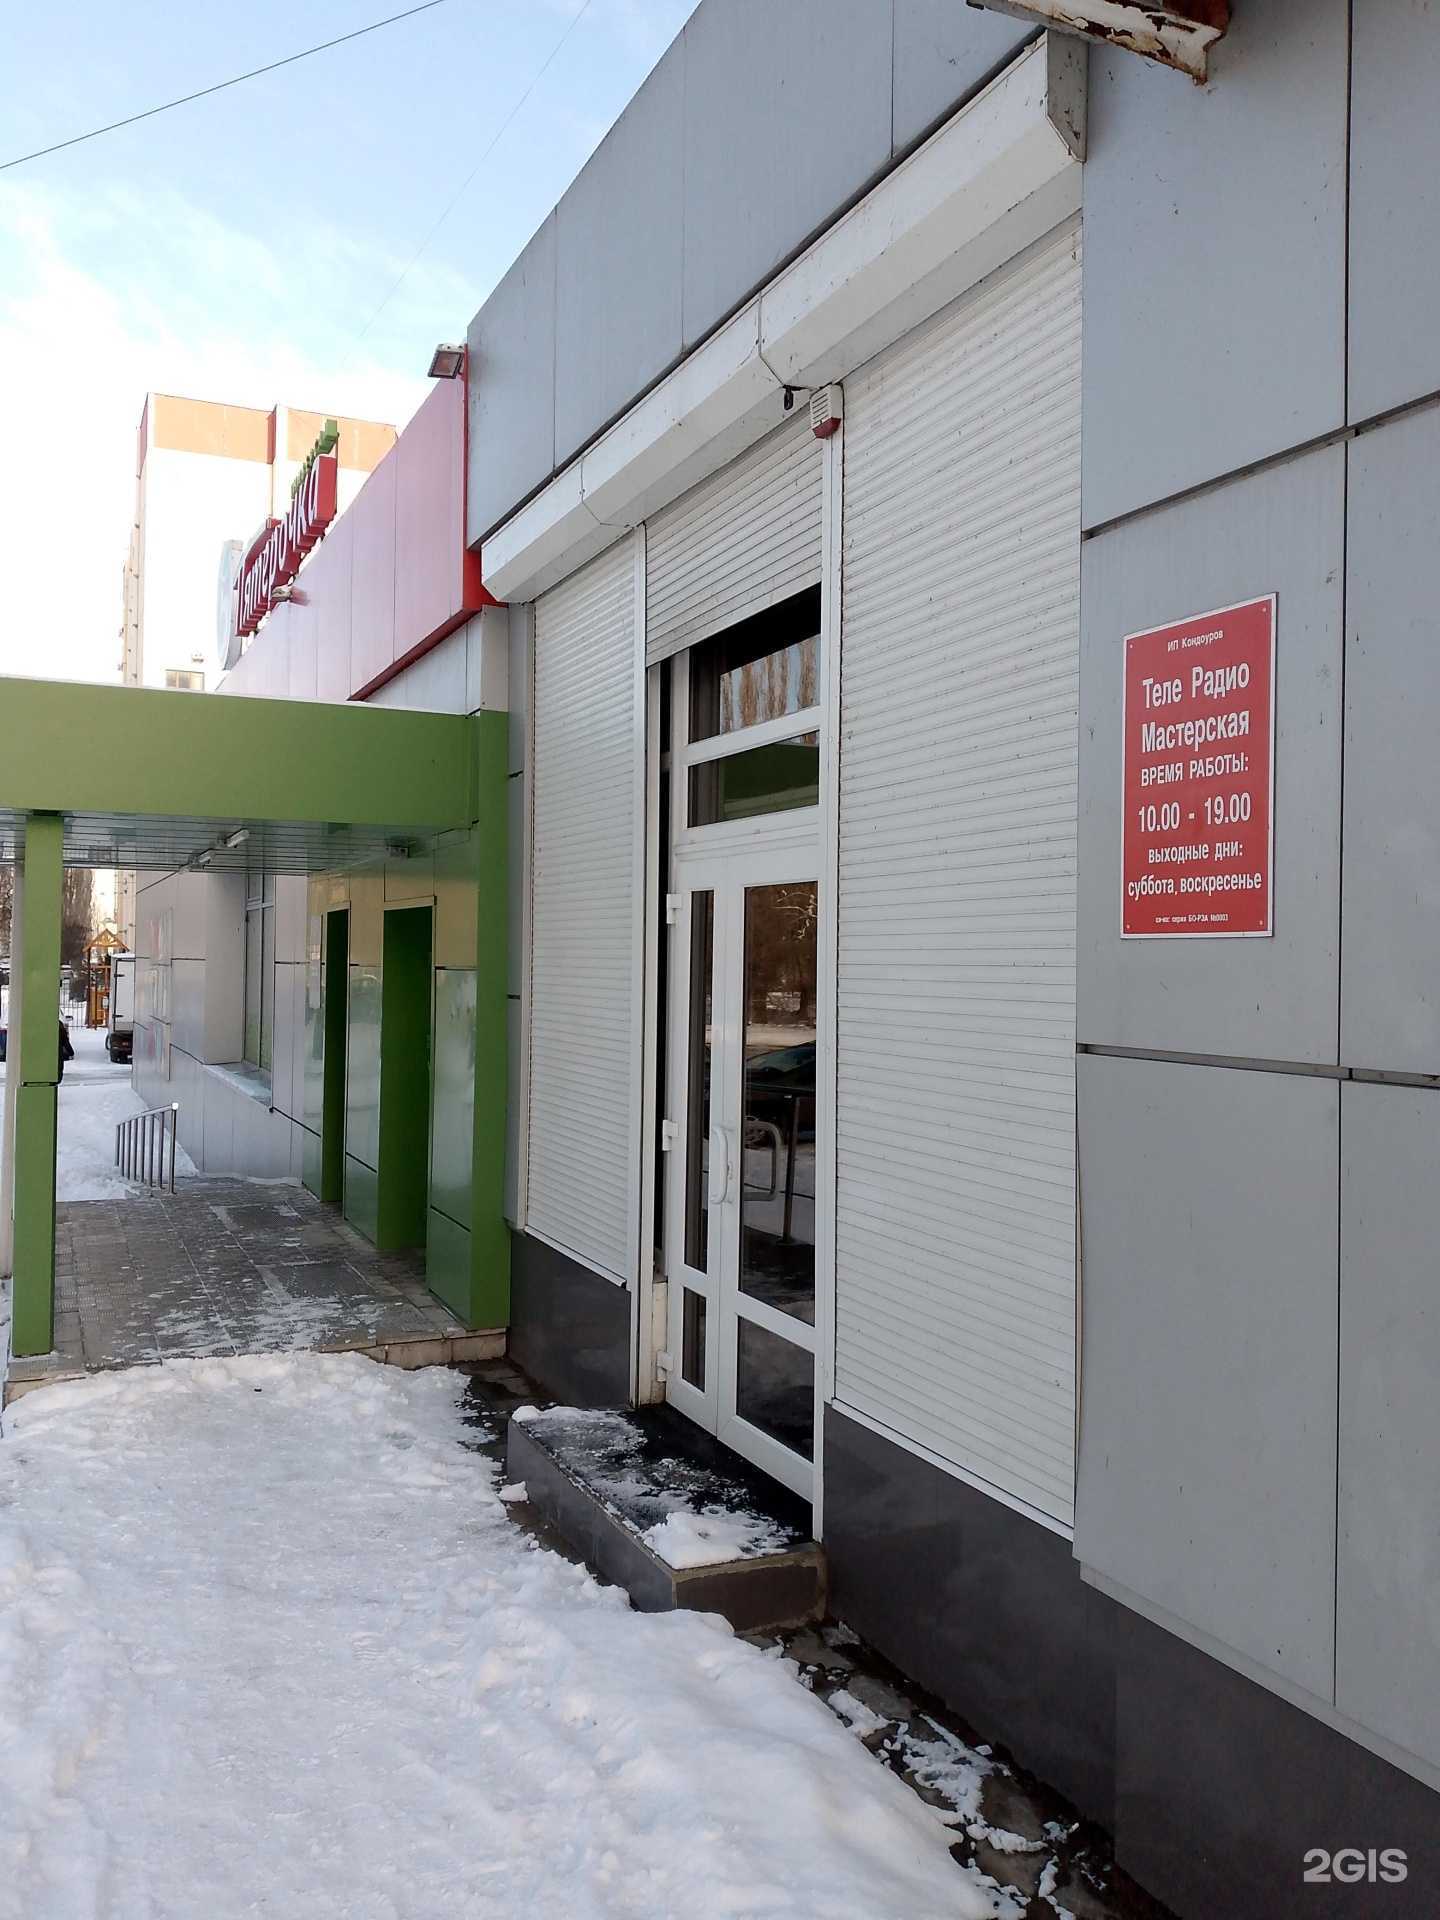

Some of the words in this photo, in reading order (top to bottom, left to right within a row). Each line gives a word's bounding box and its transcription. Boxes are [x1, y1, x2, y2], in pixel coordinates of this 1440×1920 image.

[1168, 640, 1179, 652] ИП
[1143, 677, 1182, 708] Теле
[1191, 663, 1250, 699] Радио
[1142, 710, 1249, 752] Мастерская
[1141, 763, 1183, 787] ВРЕМЯ
[1190, 752, 1249, 779] РАБОТЫ:
[1138, 802, 1180, 832] 10.00
[1204, 792, 1251, 825] 19.00
[1148, 843, 1209, 864] выходные
[1214, 841, 1243, 861] дни:
[1128, 874, 1178, 900] суббота,
[1180, 872, 1262, 896] воскресенье
